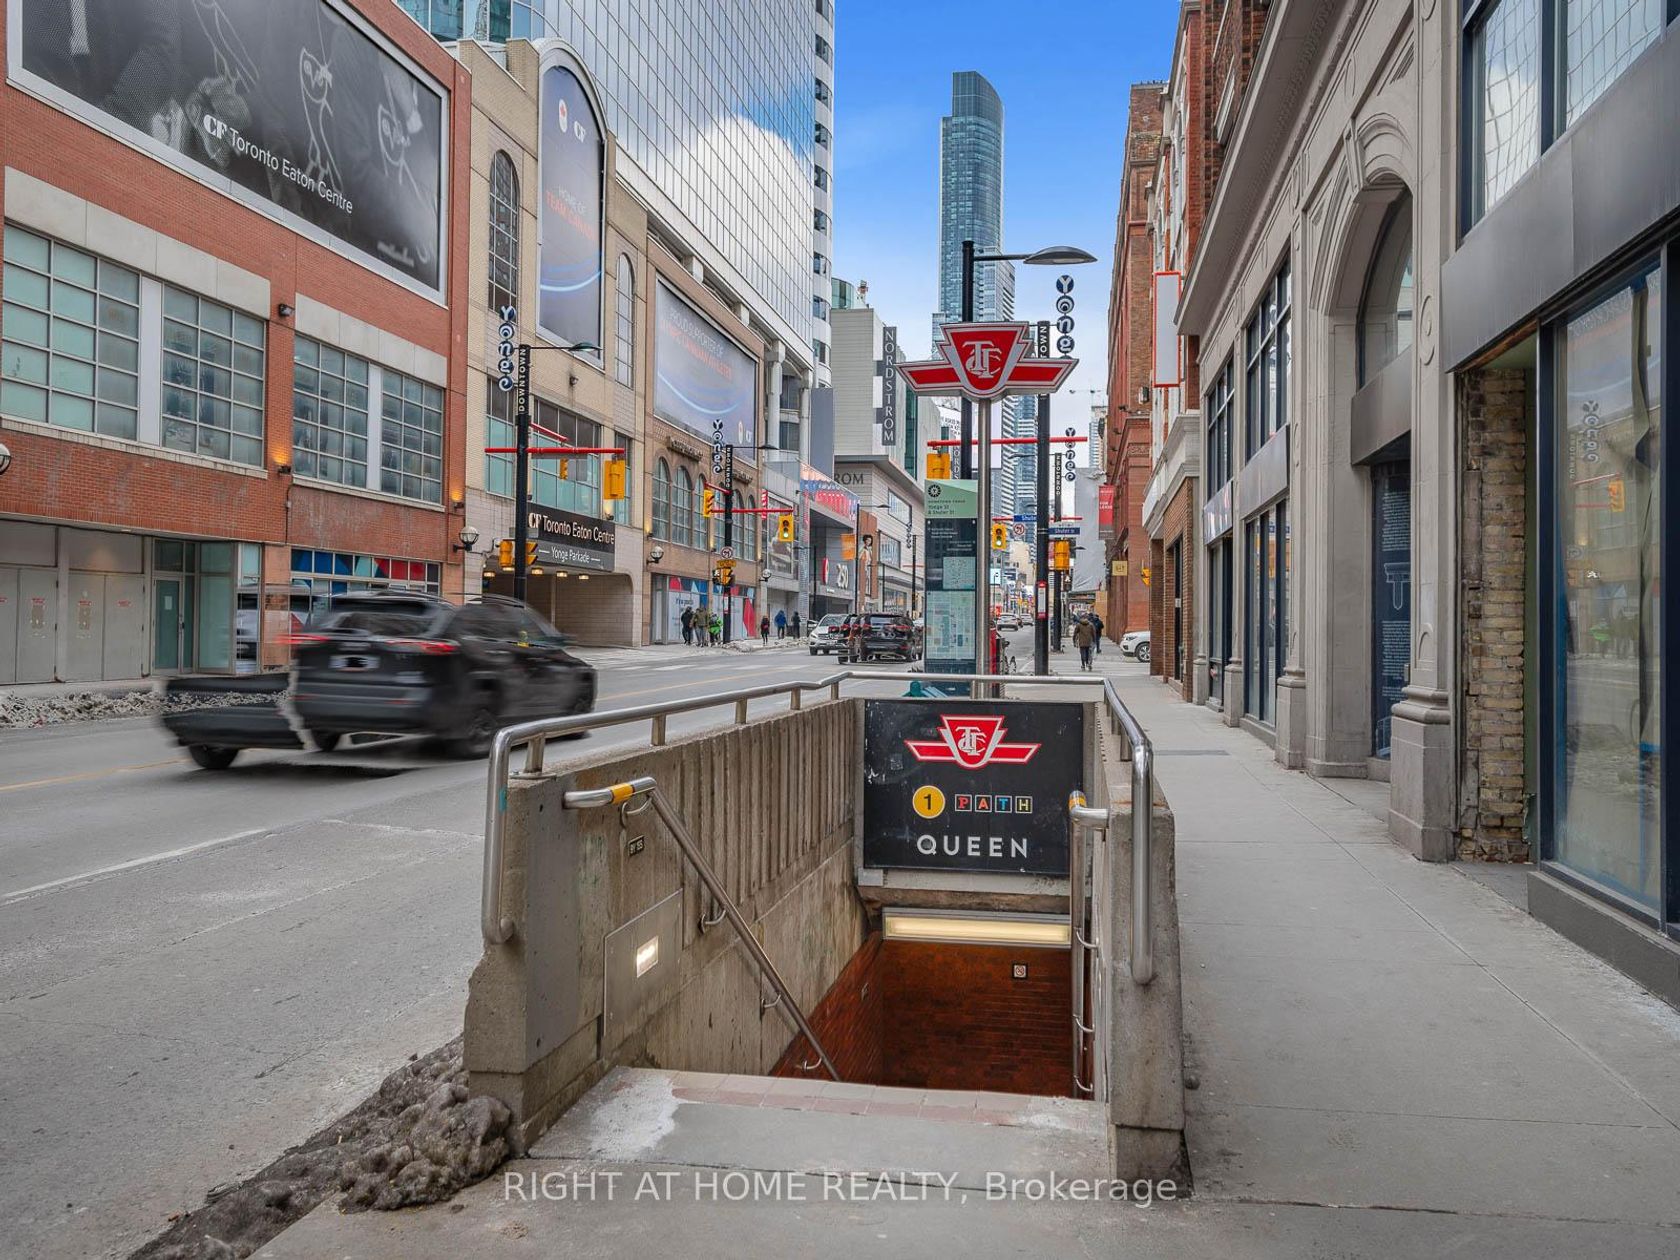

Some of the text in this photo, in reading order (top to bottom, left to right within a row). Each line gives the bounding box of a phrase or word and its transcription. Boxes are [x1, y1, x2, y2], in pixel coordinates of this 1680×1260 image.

[203, 114, 353, 214] CF Toronto Eaton Centre
[498, 305, 516, 391] Yonge
[1056, 275, 1075, 359] Yong
[518, 348, 527, 412] DOWNTOWN
[883, 330, 895, 441] NORDSTROM
[528, 512, 615, 545] CF Toronto Eaton Centre
[551, 546, 590, 564] Yonge Parkade
[923, 794, 1030, 812] 1 PATH
[917, 834, 1028, 858] QUEEN
